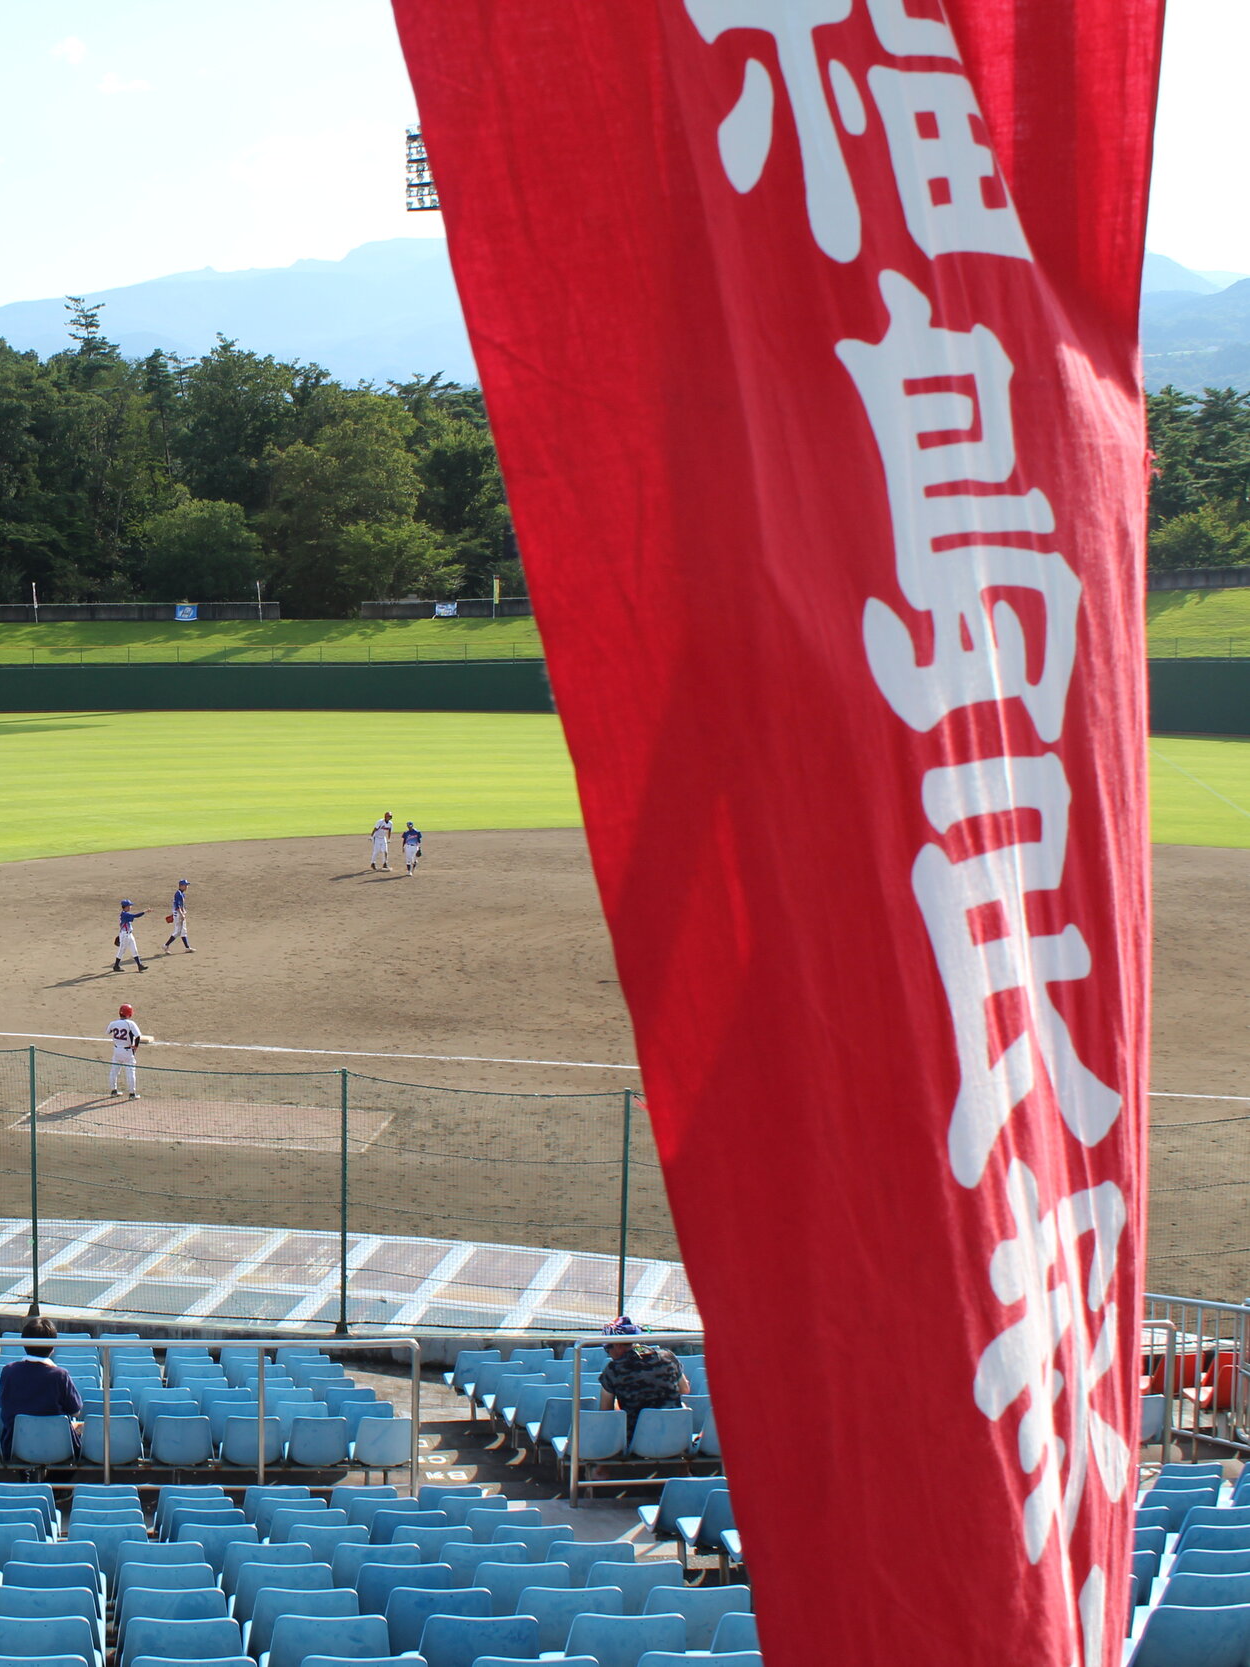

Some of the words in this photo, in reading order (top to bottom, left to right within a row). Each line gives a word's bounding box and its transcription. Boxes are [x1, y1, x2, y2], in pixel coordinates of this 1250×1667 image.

[112, 1028, 127, 1040] 22
[684, 0, 1130, 1667] 福島民報
